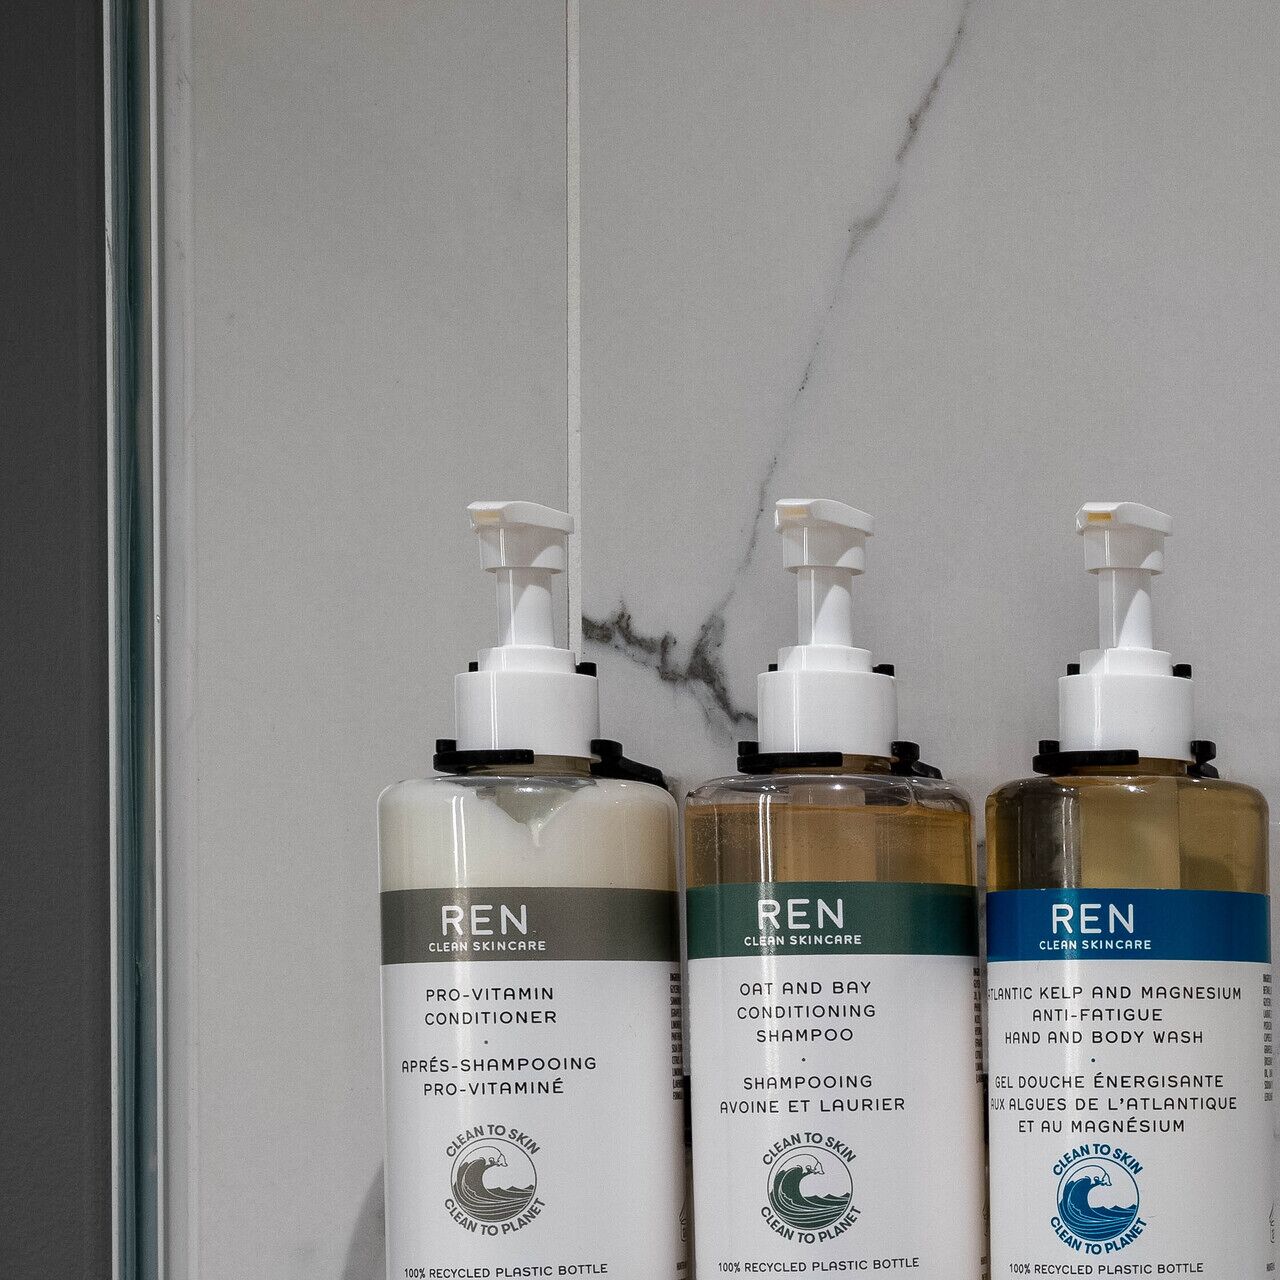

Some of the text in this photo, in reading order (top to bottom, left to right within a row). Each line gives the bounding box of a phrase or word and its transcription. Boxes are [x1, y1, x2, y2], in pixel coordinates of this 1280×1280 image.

[441, 904, 528, 937] REN
[757, 898, 844, 930] REN
[1052, 903, 1134, 934] REN
[428, 940, 547, 953] CLEAN SKINCARE
[744, 934, 862, 947] CLEAN SKINCARE
[1039, 939, 1152, 950] CLEAN SKINCARE
[427, 988, 552, 1001] PRO-VITAMIN
[740, 981, 871, 996] OAT AND BAY
[1040, 987, 1082, 999] KELP
[1092, 986, 1131, 998] AND
[1142, 986, 1240, 999] MAGNESIUM
[425, 1011, 556, 1025] CONDITIONER
[737, 1005, 875, 1019] CONDITIONING
[1033, 1008, 1162, 1021] ANTI-FATIGUE
[757, 1028, 853, 1042] SHAMPOO
[1006, 1031, 1202, 1044] HAND AND BODY WASH
[402, 1056, 596, 1073] APRÉS-SHAMPOOING
[424, 1077, 564, 1096] PRO-VITAMINÉ
[744, 1075, 872, 1090] SHAMPOOING
[995, 1072, 1223, 1088] GEL DOUCHE ÉNERGISANTE
[720, 1098, 904, 1113] AVOINE ET LAURIER
[1009, 1098, 1066, 1111] ALGUES
[1076, 1098, 1098, 1110] DE
[1019, 1116, 1184, 1133] ET AU MAGNÉSIUM
[446, 1124, 541, 1158] CLEAN TO SKIN
[762, 1132, 857, 1166] CLEAN TO SKIN
[1052, 1142, 1144, 1176] CLEAN TO SKIN
[444, 1198, 546, 1237] CLEAN TO PLANET
[760, 1205, 862, 1244] CLEAN TO PLANET
[1050, 1216, 1148, 1256] CLEAN TO PLANET
[405, 1264, 608, 1279] 100% RECYCLED PLASTIC BOTTLE
[719, 1257, 919, 1273] 100% RECYCLED PLASTIC BOTTLE
[1010, 1263, 1203, 1275] 100% RECYCLED PLASTIC BOTTLE
